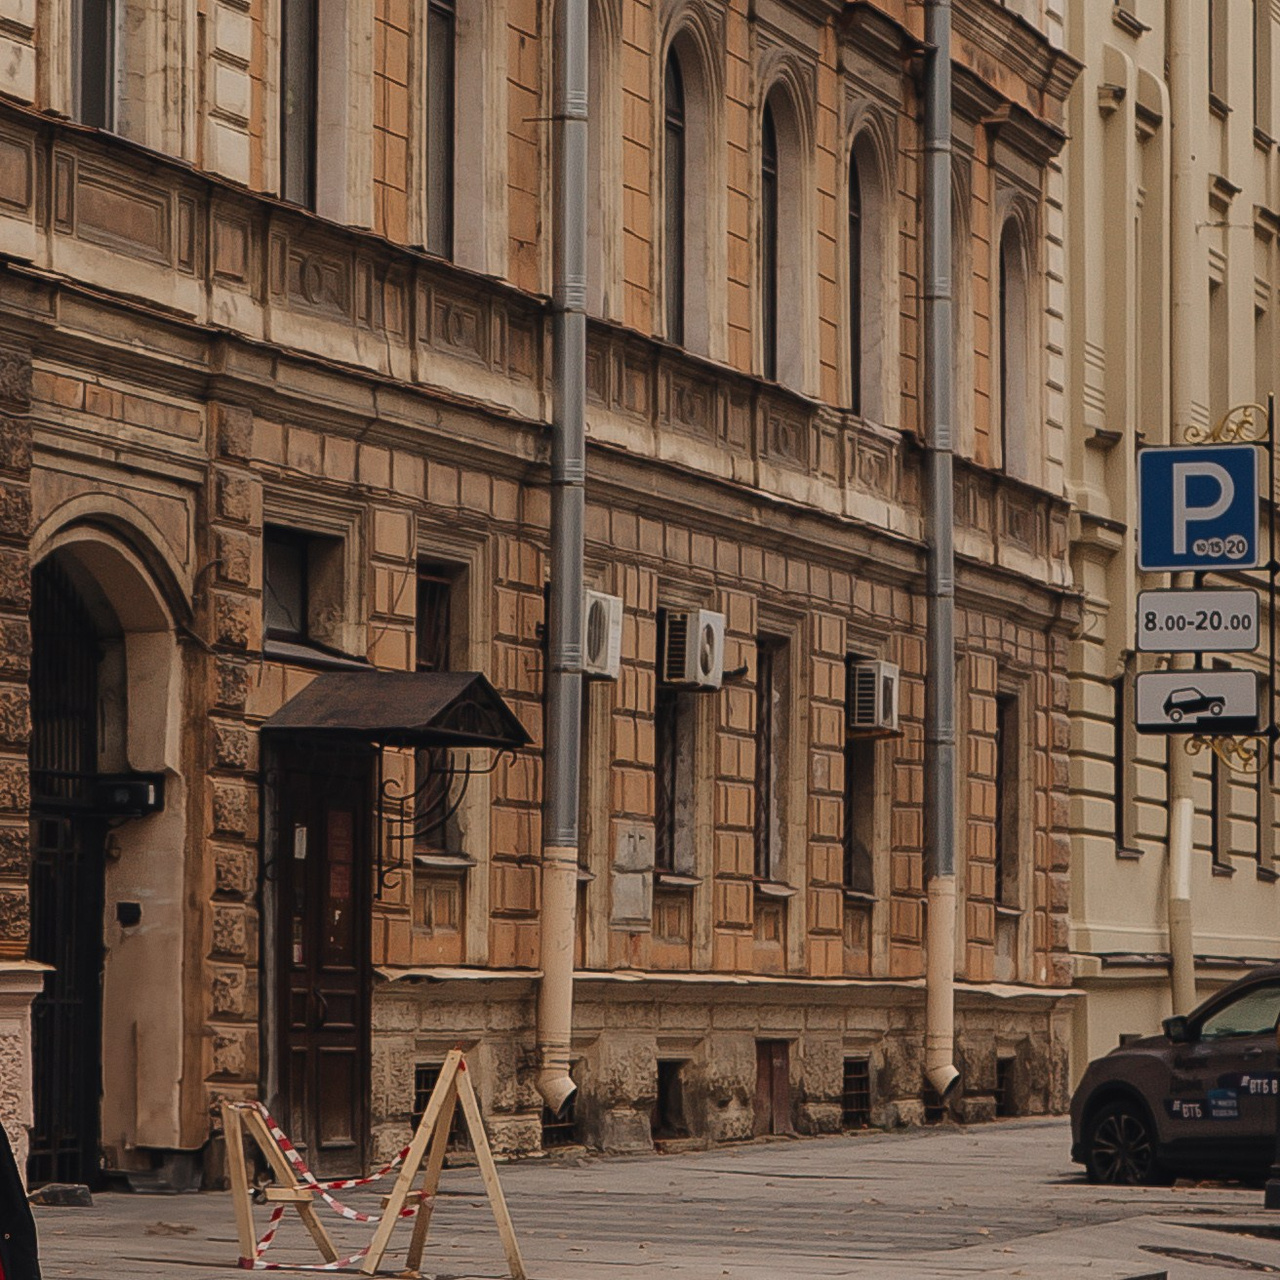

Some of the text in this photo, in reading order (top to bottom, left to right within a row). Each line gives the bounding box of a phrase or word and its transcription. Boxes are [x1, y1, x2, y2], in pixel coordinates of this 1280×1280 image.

[1173, 462, 1235, 555] P
[1196, 539, 1246, 554] 10 15 20
[1144, 611, 1252, 631] 8.00-20.00
[1182, 1104, 1202, 1118] ВТБ
